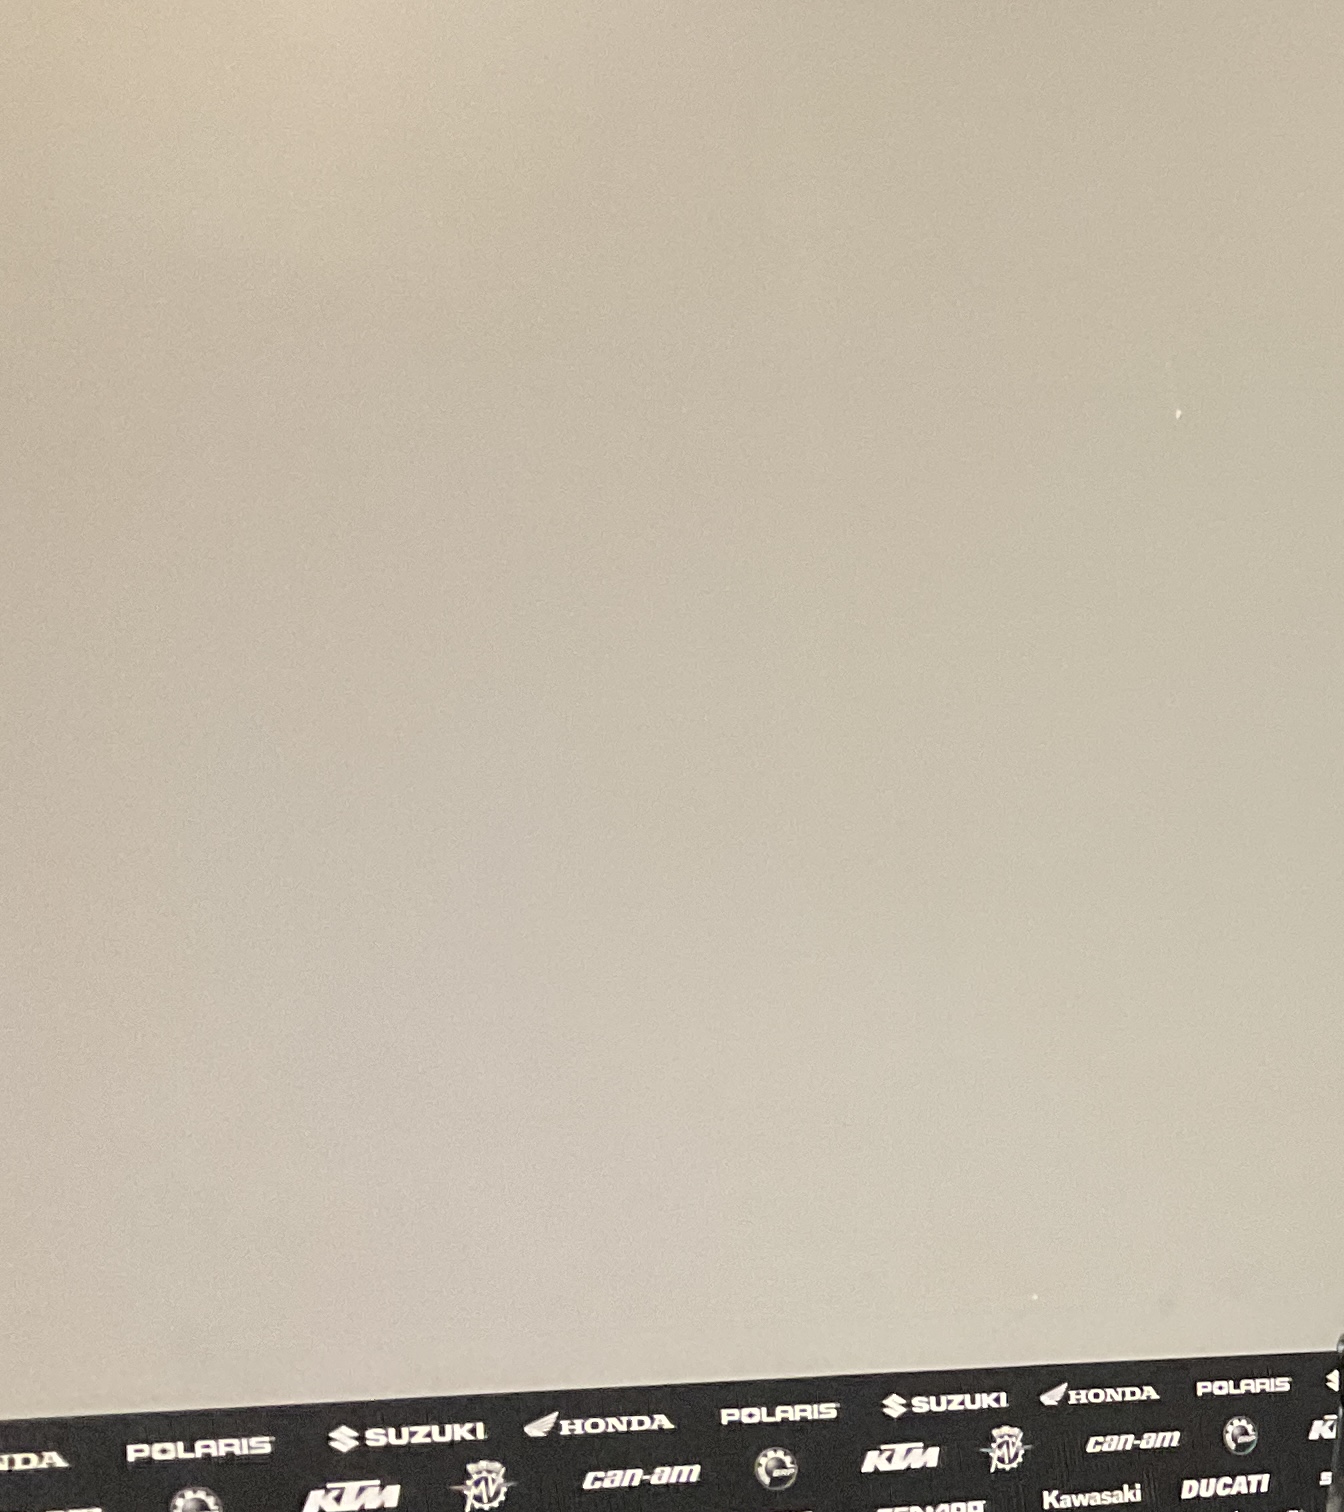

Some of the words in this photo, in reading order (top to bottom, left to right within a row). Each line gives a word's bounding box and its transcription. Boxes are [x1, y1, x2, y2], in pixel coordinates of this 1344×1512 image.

[1070, 1386, 1160, 1404] HONDA
[1197, 1377, 1292, 1396] POLARIS
[720, 1403, 840, 1425] POLARIS
[911, 1392, 1009, 1413] SUZUKI
[365, 1422, 488, 1446] SUZUKI
[561, 1414, 674, 1435] HONDA
[126, 1436, 275, 1462] POLARIS
[1086, 1431, 1180, 1453] can-am
[861, 1442, 940, 1473] KTM
[582, 1464, 701, 1489] can-am
[1181, 1474, 1270, 1499] DUCATI
[1043, 1483, 1141, 1510] Kawasaki
